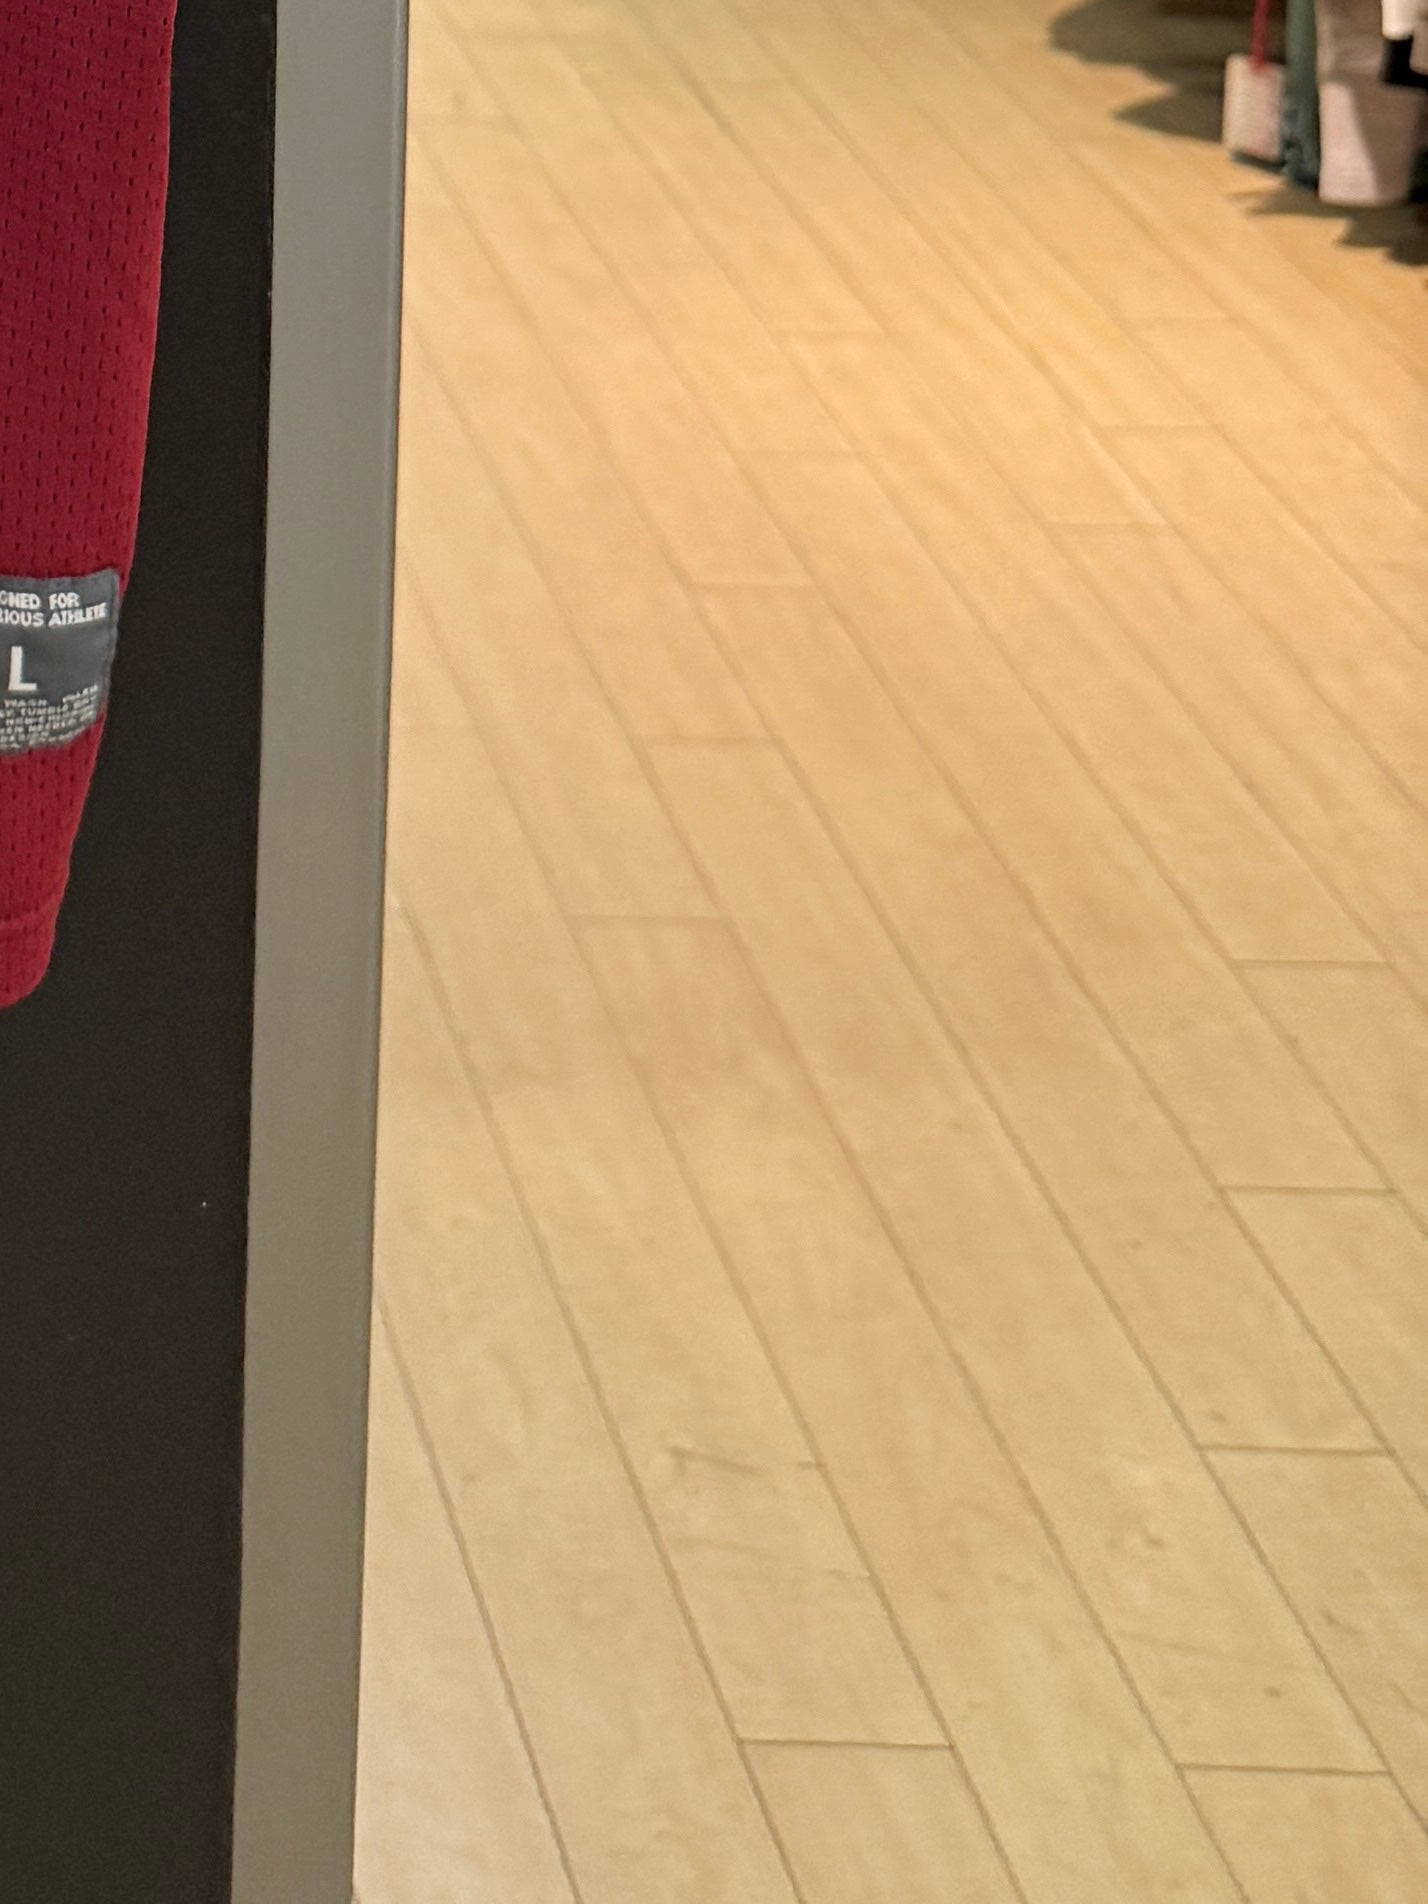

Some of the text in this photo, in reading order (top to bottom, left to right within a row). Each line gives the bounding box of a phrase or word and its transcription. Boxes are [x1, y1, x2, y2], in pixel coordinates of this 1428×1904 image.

[48, 592, 80, 609] FOR
[47, 602, 108, 627] ATHLETE
[8, 645, 38, 691] L
